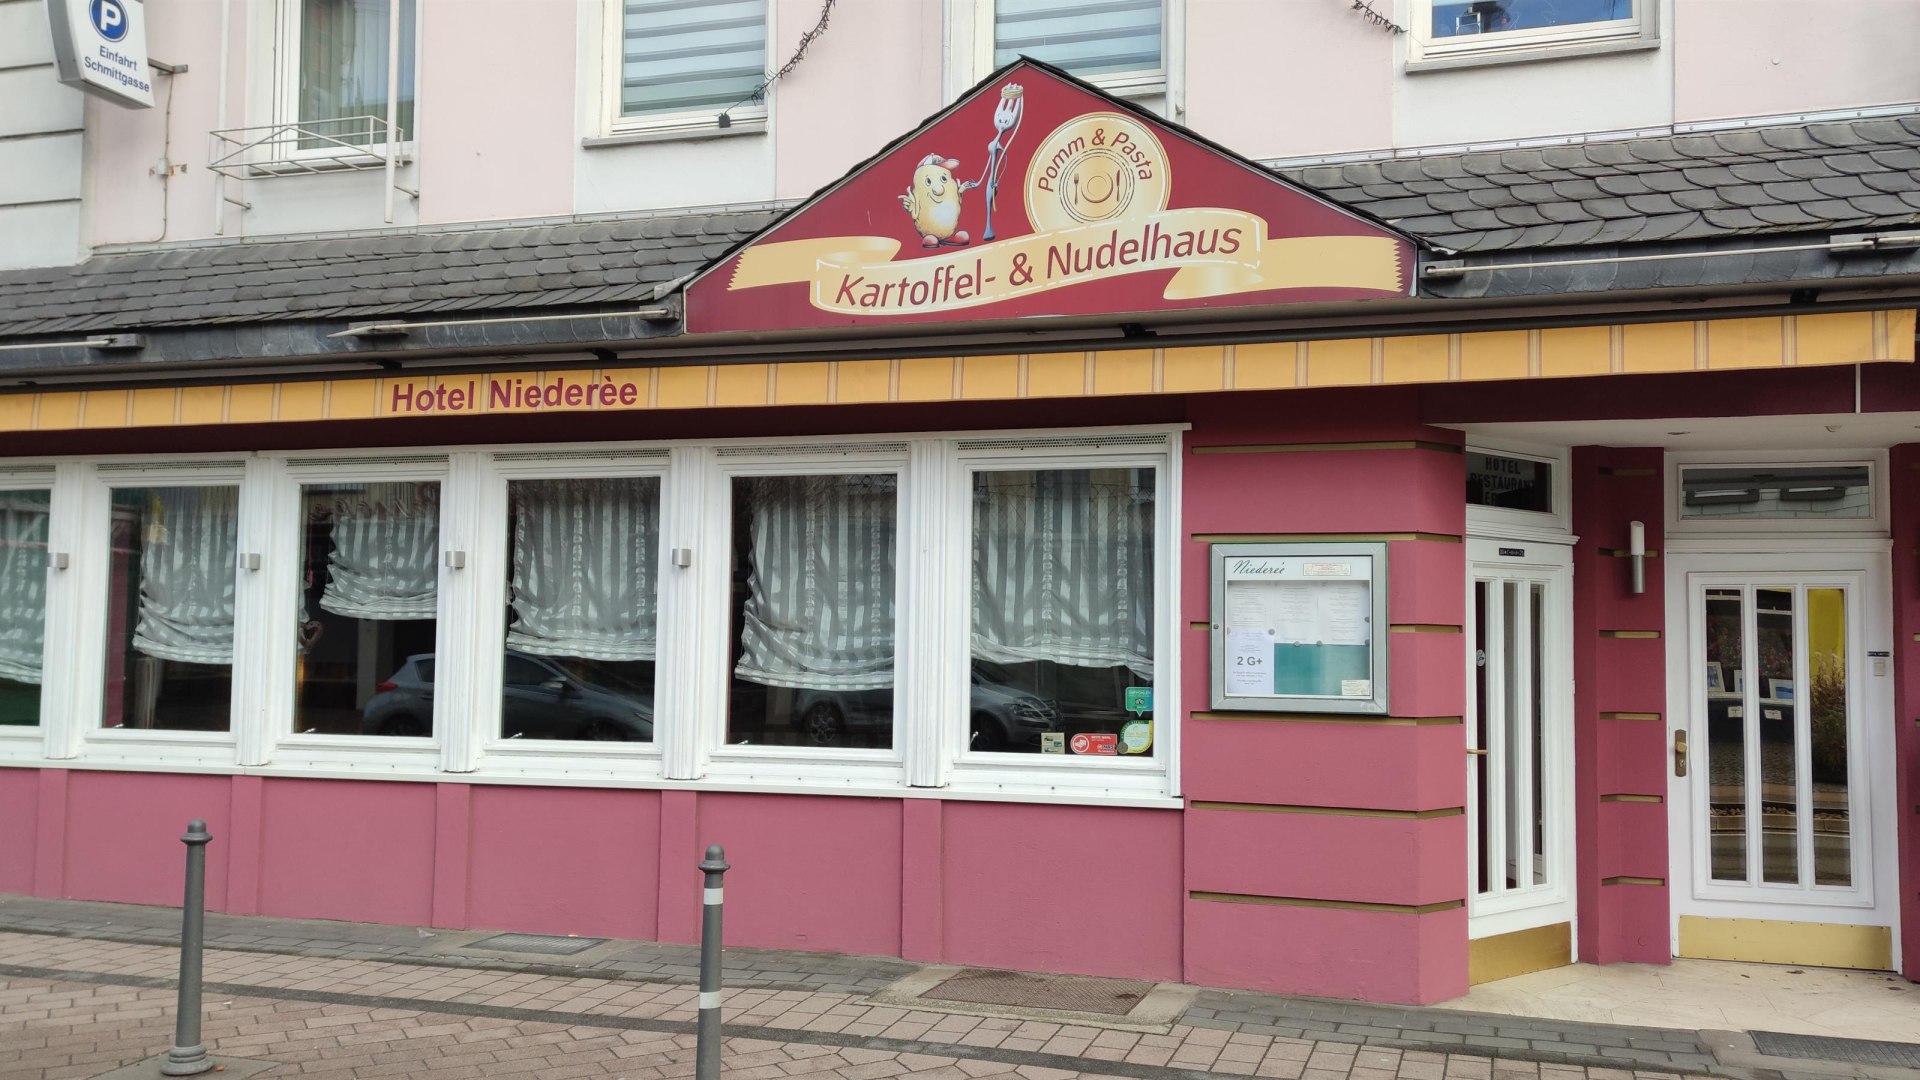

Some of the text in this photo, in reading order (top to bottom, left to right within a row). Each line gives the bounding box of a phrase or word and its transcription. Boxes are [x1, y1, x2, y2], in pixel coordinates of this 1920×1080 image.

[100, 1, 121, 31] P
[84, 56, 150, 92] Schmittgasse
[100, 45, 137, 71] Einfahrt
[1038, 128, 1152, 192] Pomm & Pasta
[835, 222, 1242, 307] Kartoffel- & Nudelhaus
[391, 376, 638, 411] Hotel Niederèe
[1485, 456, 1521, 474] HOTEL
[1237, 656, 1263, 666] 2 G+
